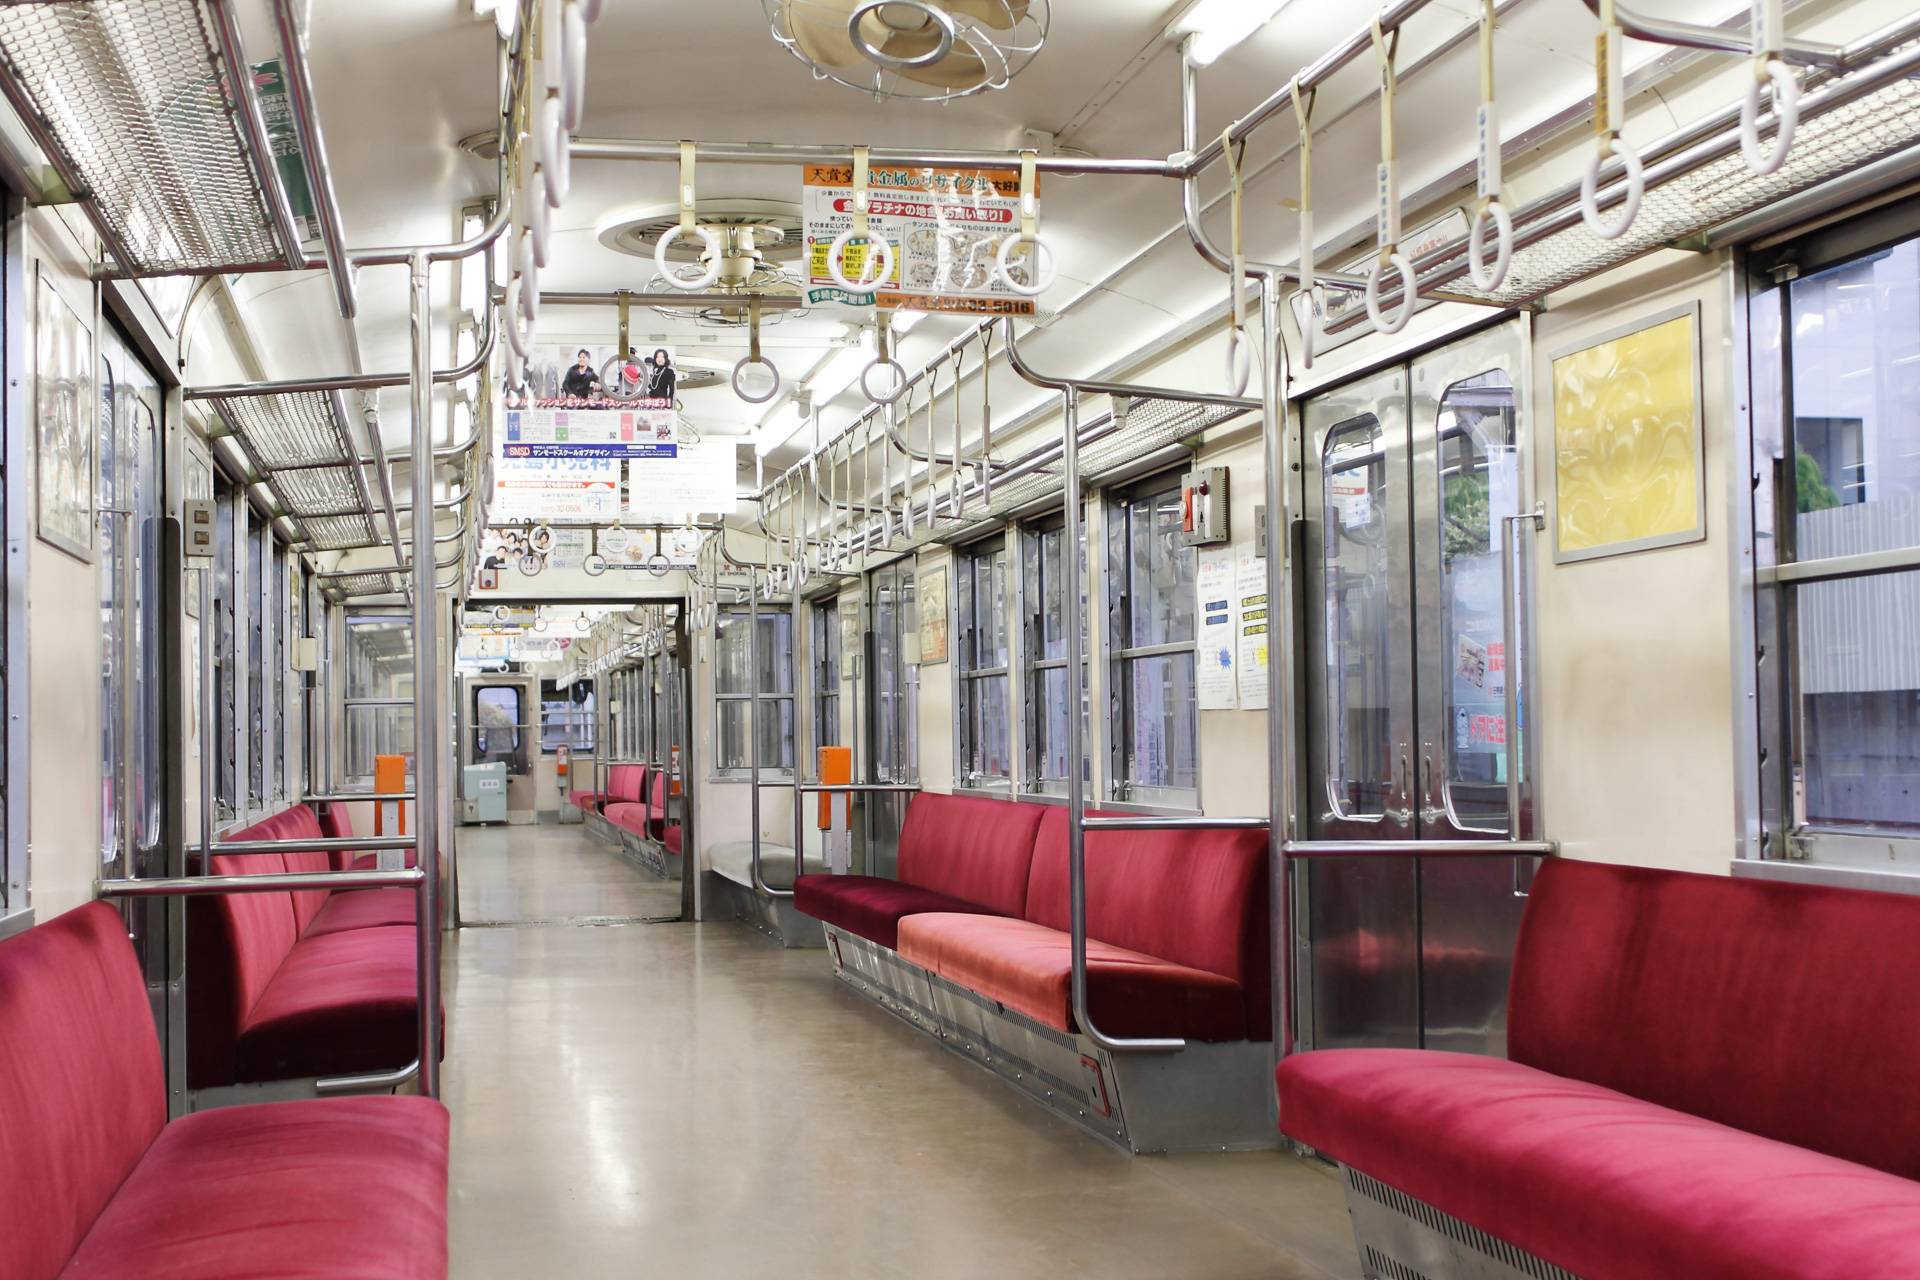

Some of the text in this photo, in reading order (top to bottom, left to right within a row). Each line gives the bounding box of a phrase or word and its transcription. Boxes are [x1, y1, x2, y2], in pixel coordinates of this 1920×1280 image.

[509, 447, 530, 455] SMSD
[1470, 713, 1507, 744] ドアに注
